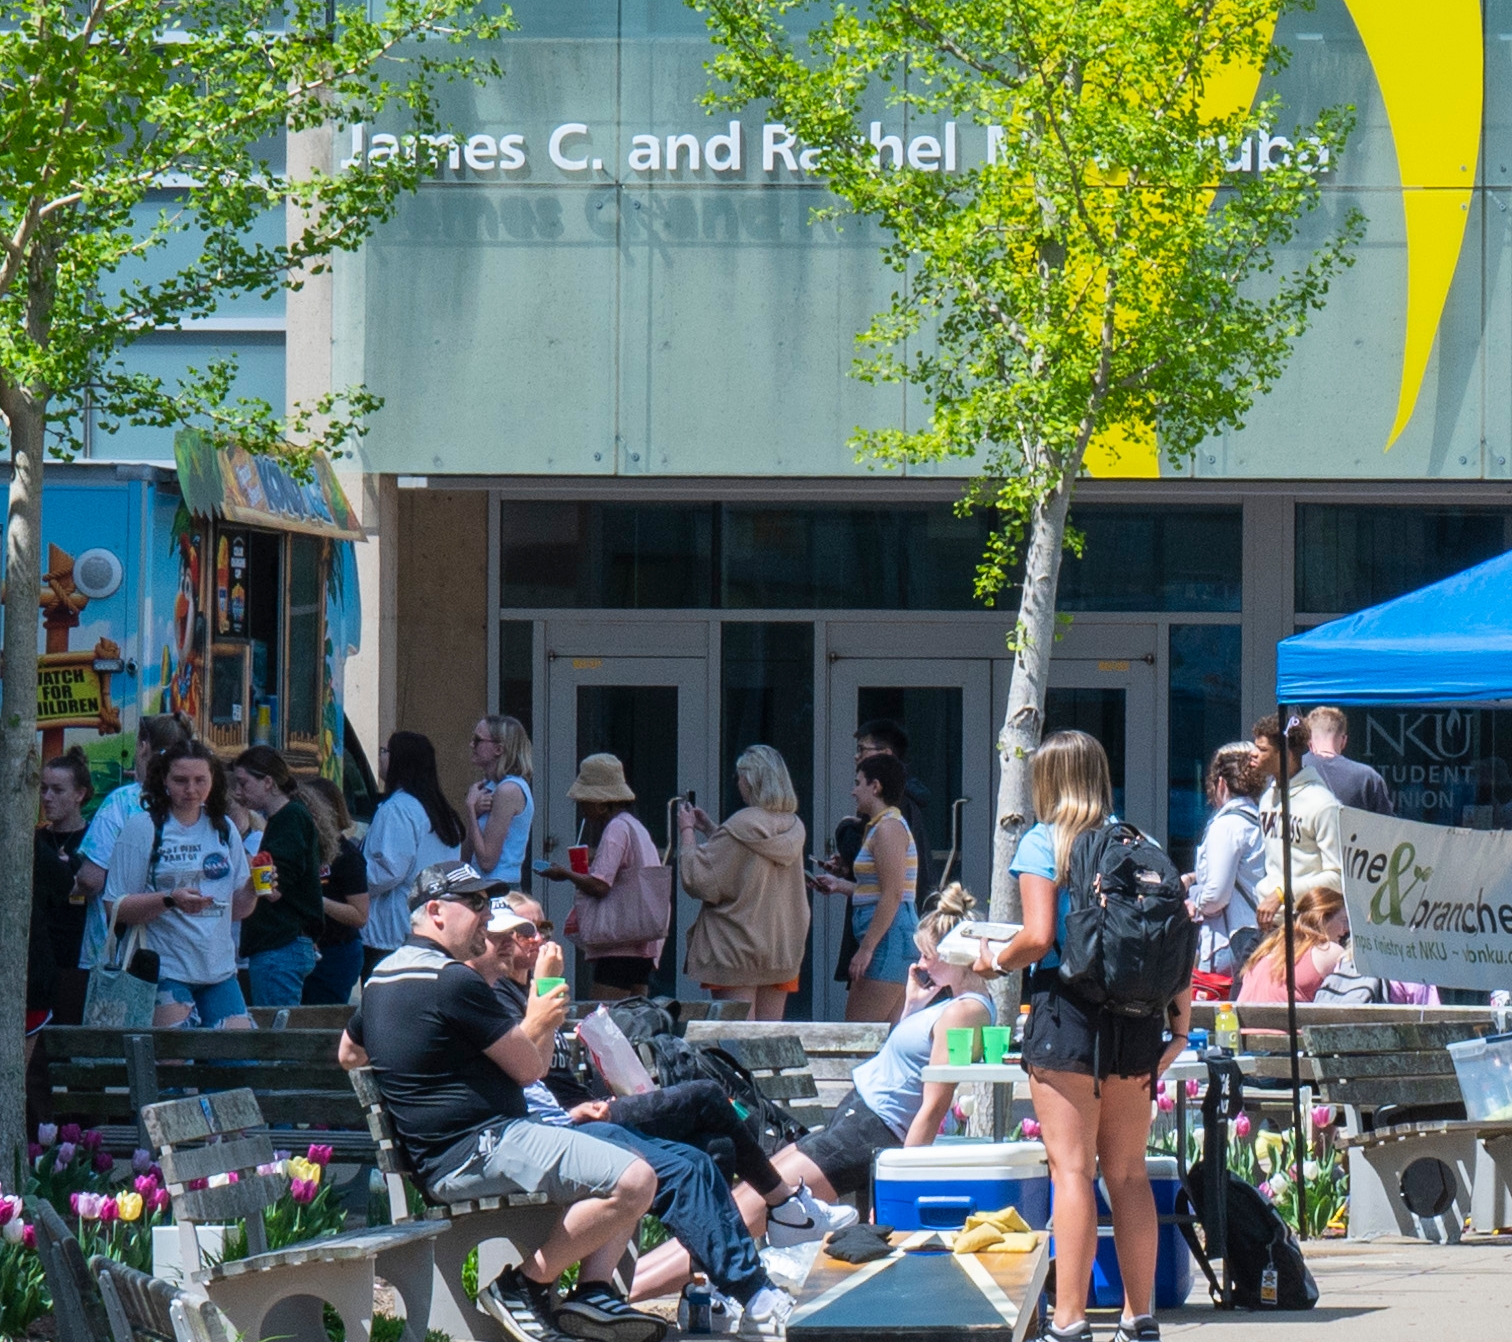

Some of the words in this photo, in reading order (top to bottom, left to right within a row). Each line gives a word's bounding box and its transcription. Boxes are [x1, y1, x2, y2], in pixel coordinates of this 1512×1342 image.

[548, 122, 605, 171] C.
[629, 121, 742, 171] and
[42, 686, 73, 701] FOR
[1364, 711, 1475, 761] NKU
[1377, 765, 1475, 785] TUDENT
[1419, 940, 1448, 961] NKU
